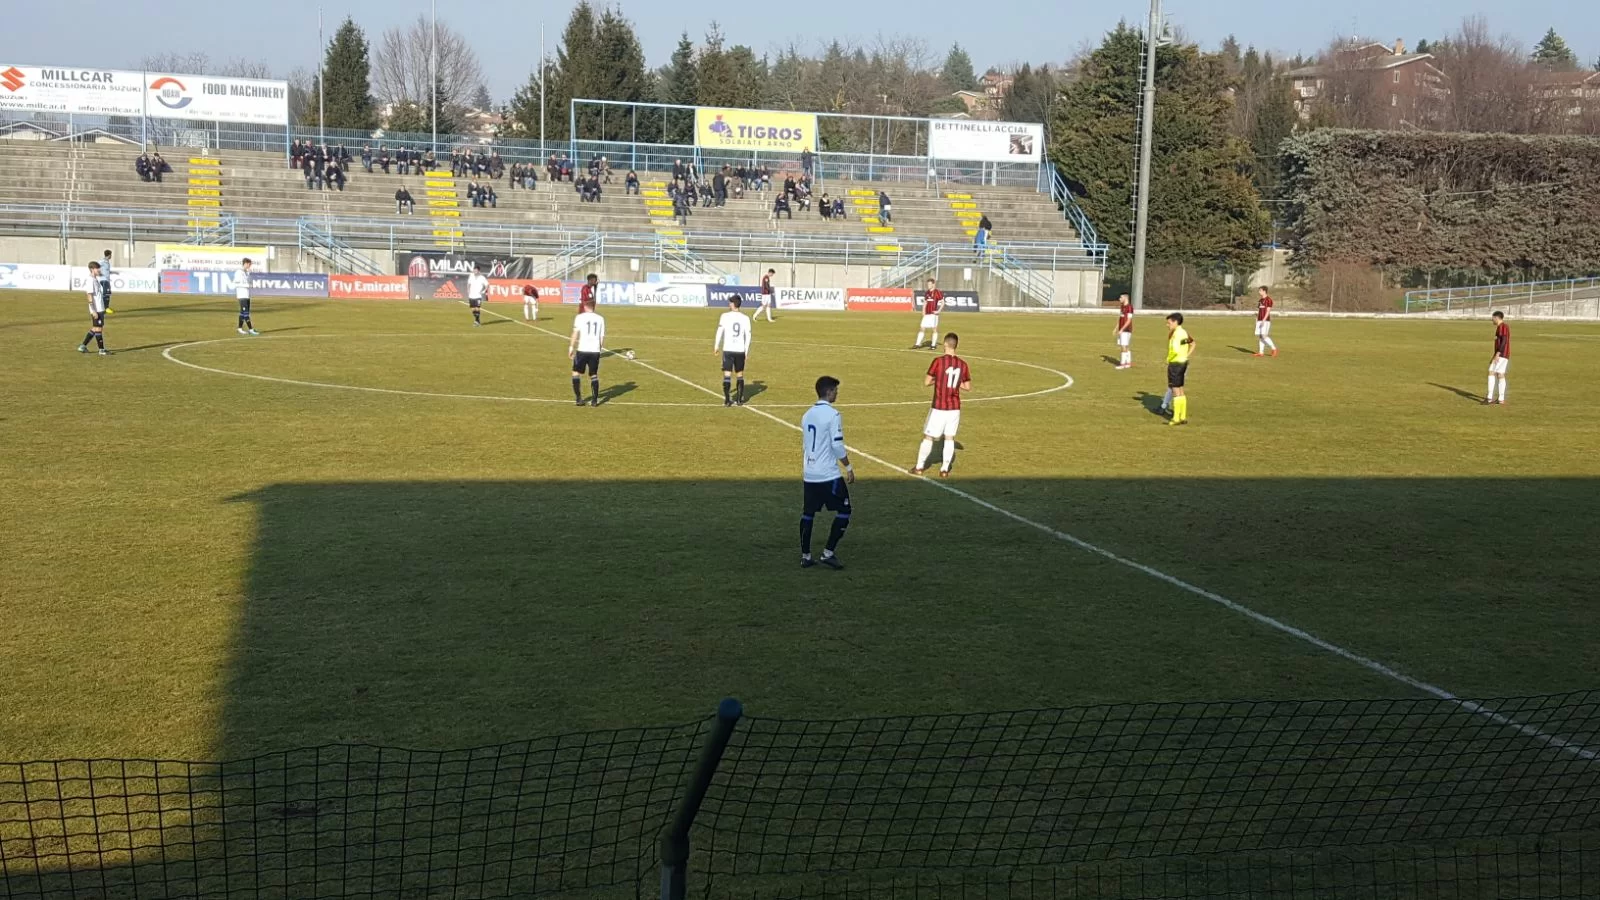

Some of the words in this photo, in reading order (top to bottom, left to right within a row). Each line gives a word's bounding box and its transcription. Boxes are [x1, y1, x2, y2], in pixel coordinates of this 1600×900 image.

[41, 69, 114, 83] MILLCAR
[29, 81, 107, 91] CONCESSIONARIA
[203, 83, 227, 95] FOOD
[230, 85, 285, 99] MACHINERY
[0, 102, 66, 110] www.millcar.it
[738, 125, 803, 140] TIGROS
[429, 259, 475, 272] MILAN
[22, 272, 55, 281] Group
[193, 271, 240, 293] TIM
[128, 279, 156, 289] BPM
[252, 279, 291, 289] NIVEA
[293, 281, 324, 290] MEN
[331, 280, 353, 293] Fly
[355, 281, 408, 292] Emirates
[489, 284, 509, 297] Fly
[511, 284, 561, 296] Eates
[637, 293, 679, 304] BANCO
[780, 289, 840, 301] PREMIUM
[848, 295, 912, 304] FRECCIAROSSA
[586, 321, 598, 336] 11
[732, 322, 741, 338] 9
[945, 366, 961, 389] 11
[807, 424, 817, 453] 7
